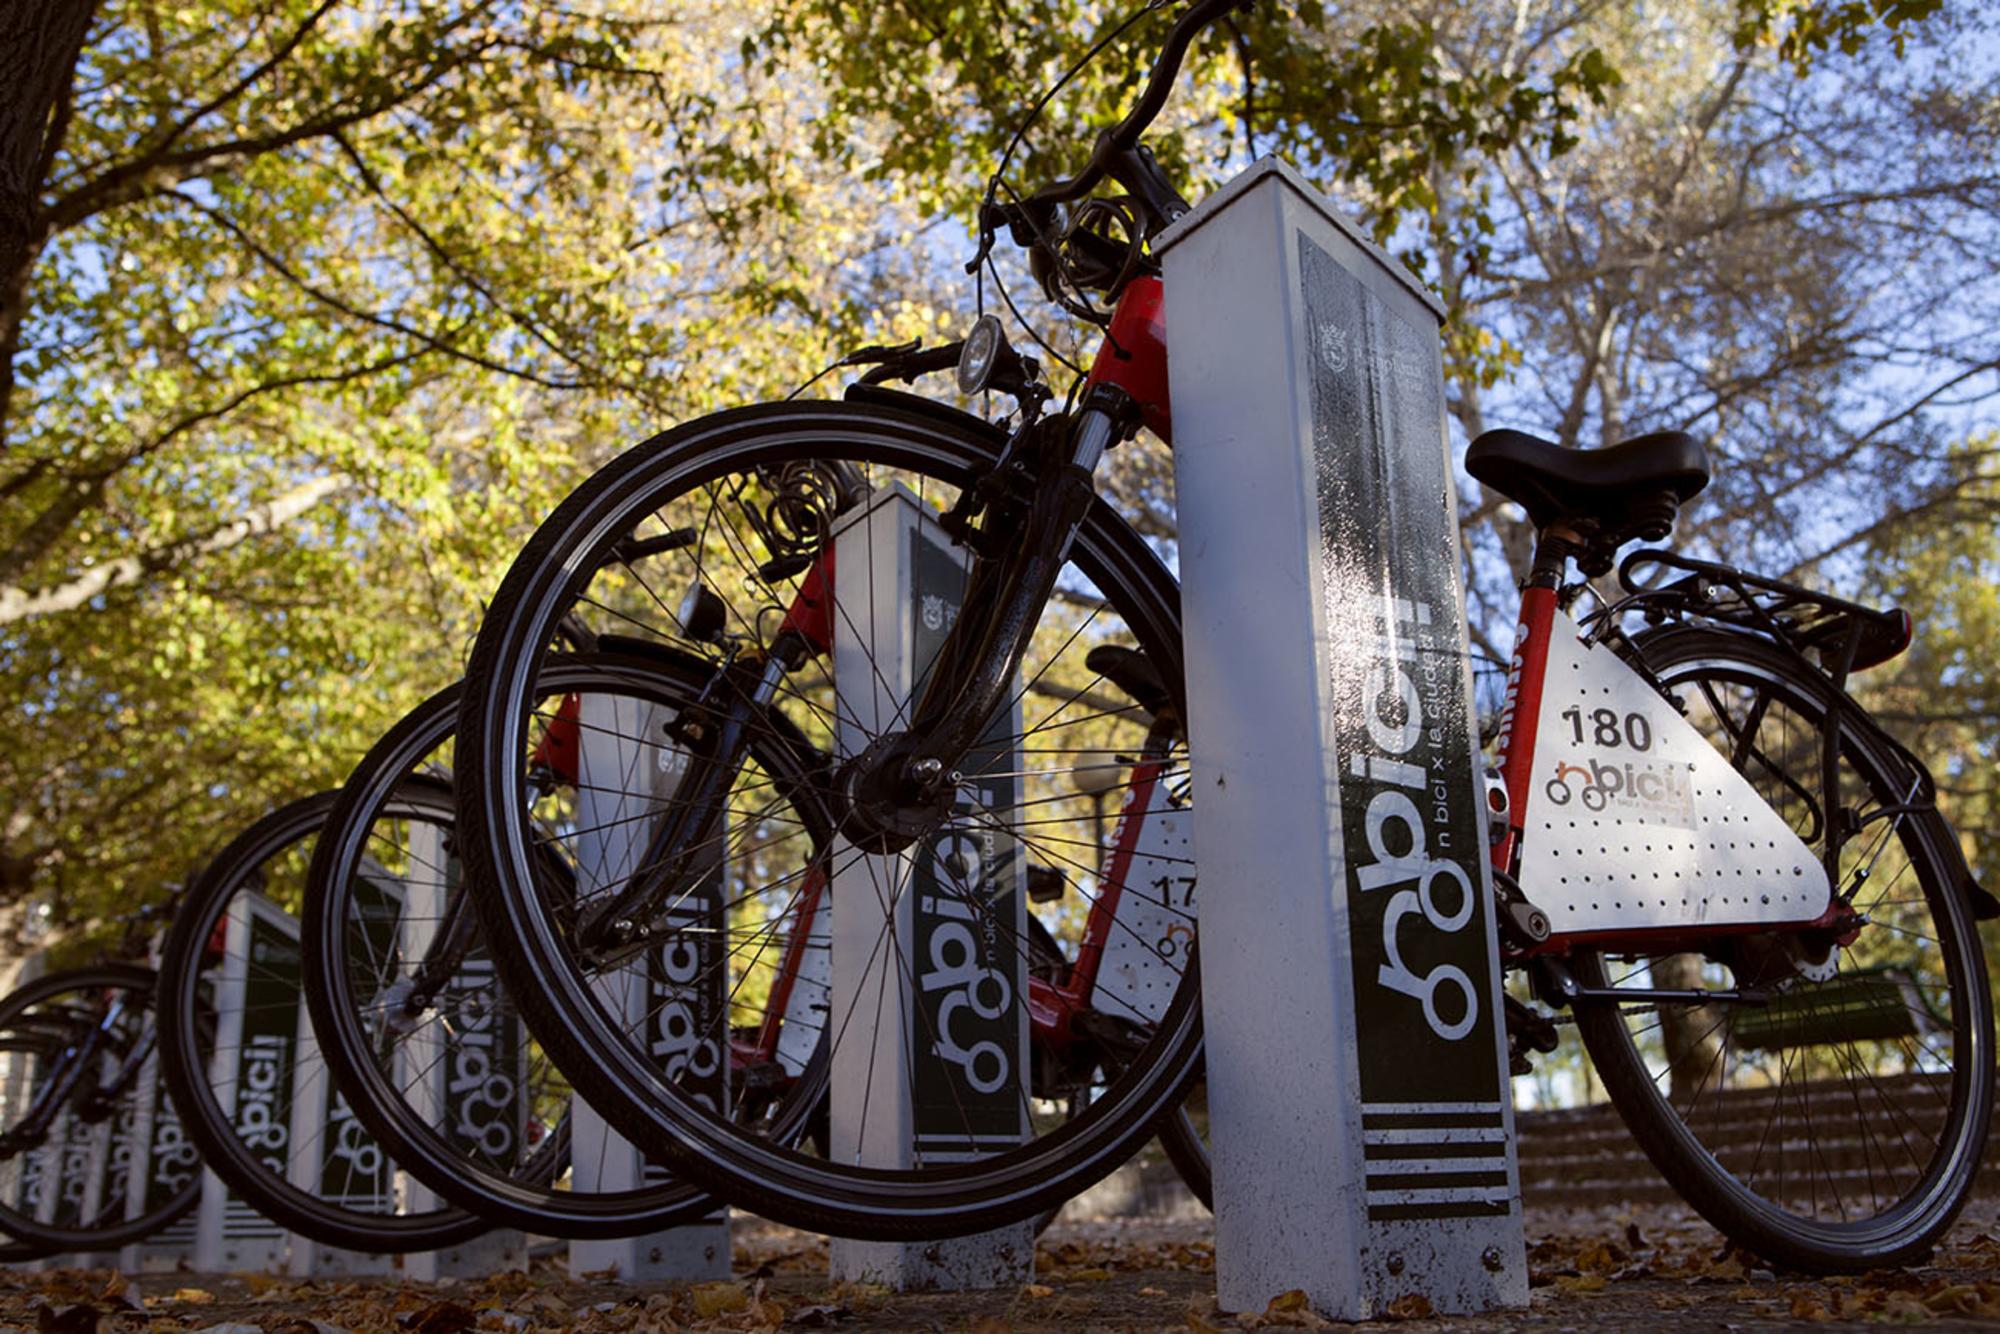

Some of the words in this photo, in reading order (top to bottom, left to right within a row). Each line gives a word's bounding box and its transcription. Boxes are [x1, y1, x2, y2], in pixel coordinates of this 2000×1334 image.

[1427, 726, 1443, 749] la
[1562, 704, 1653, 753] 180
[1431, 757, 1445, 771] x
[1428, 777, 1451, 823] bici
[1436, 831, 1451, 848] n
[983, 912, 997, 944] bic
